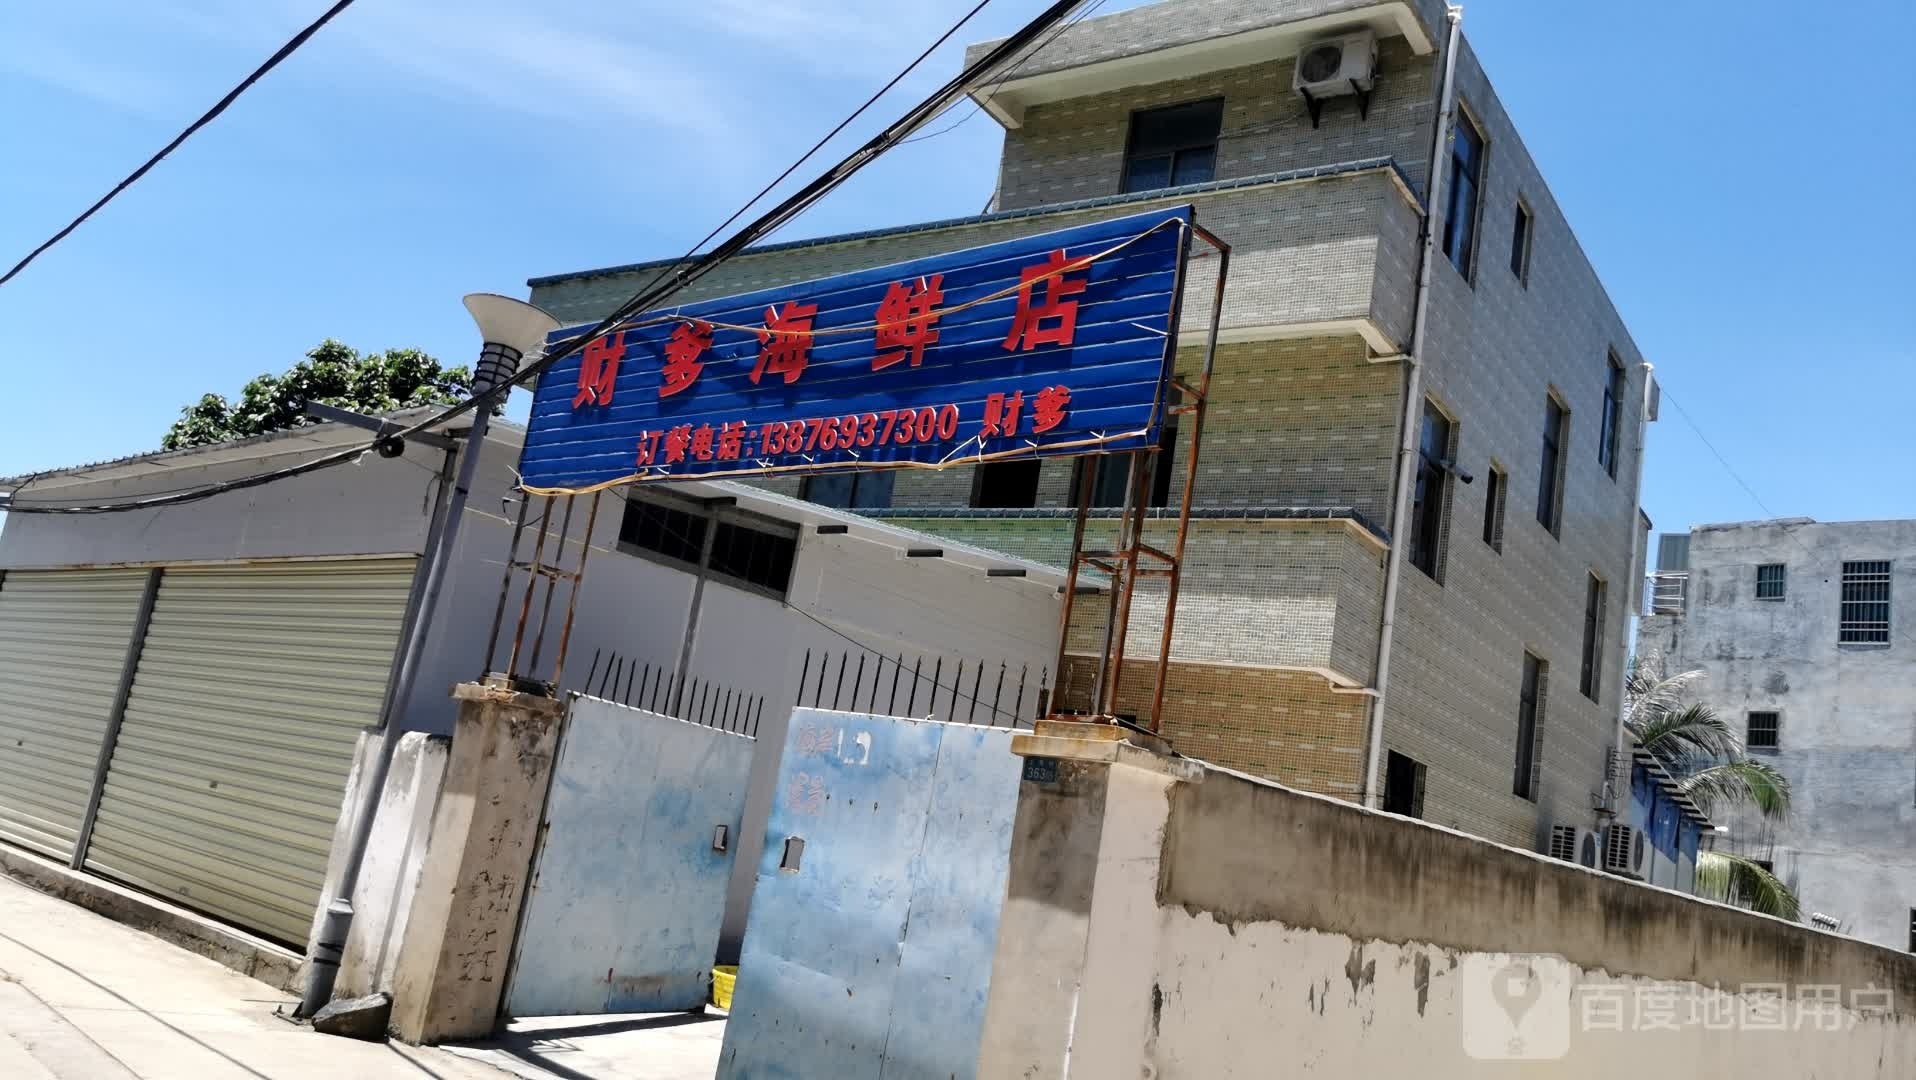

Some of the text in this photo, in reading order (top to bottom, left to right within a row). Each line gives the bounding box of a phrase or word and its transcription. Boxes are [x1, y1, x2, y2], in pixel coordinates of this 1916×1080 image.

[572, 248, 1092, 409] 财爹海鲜店
